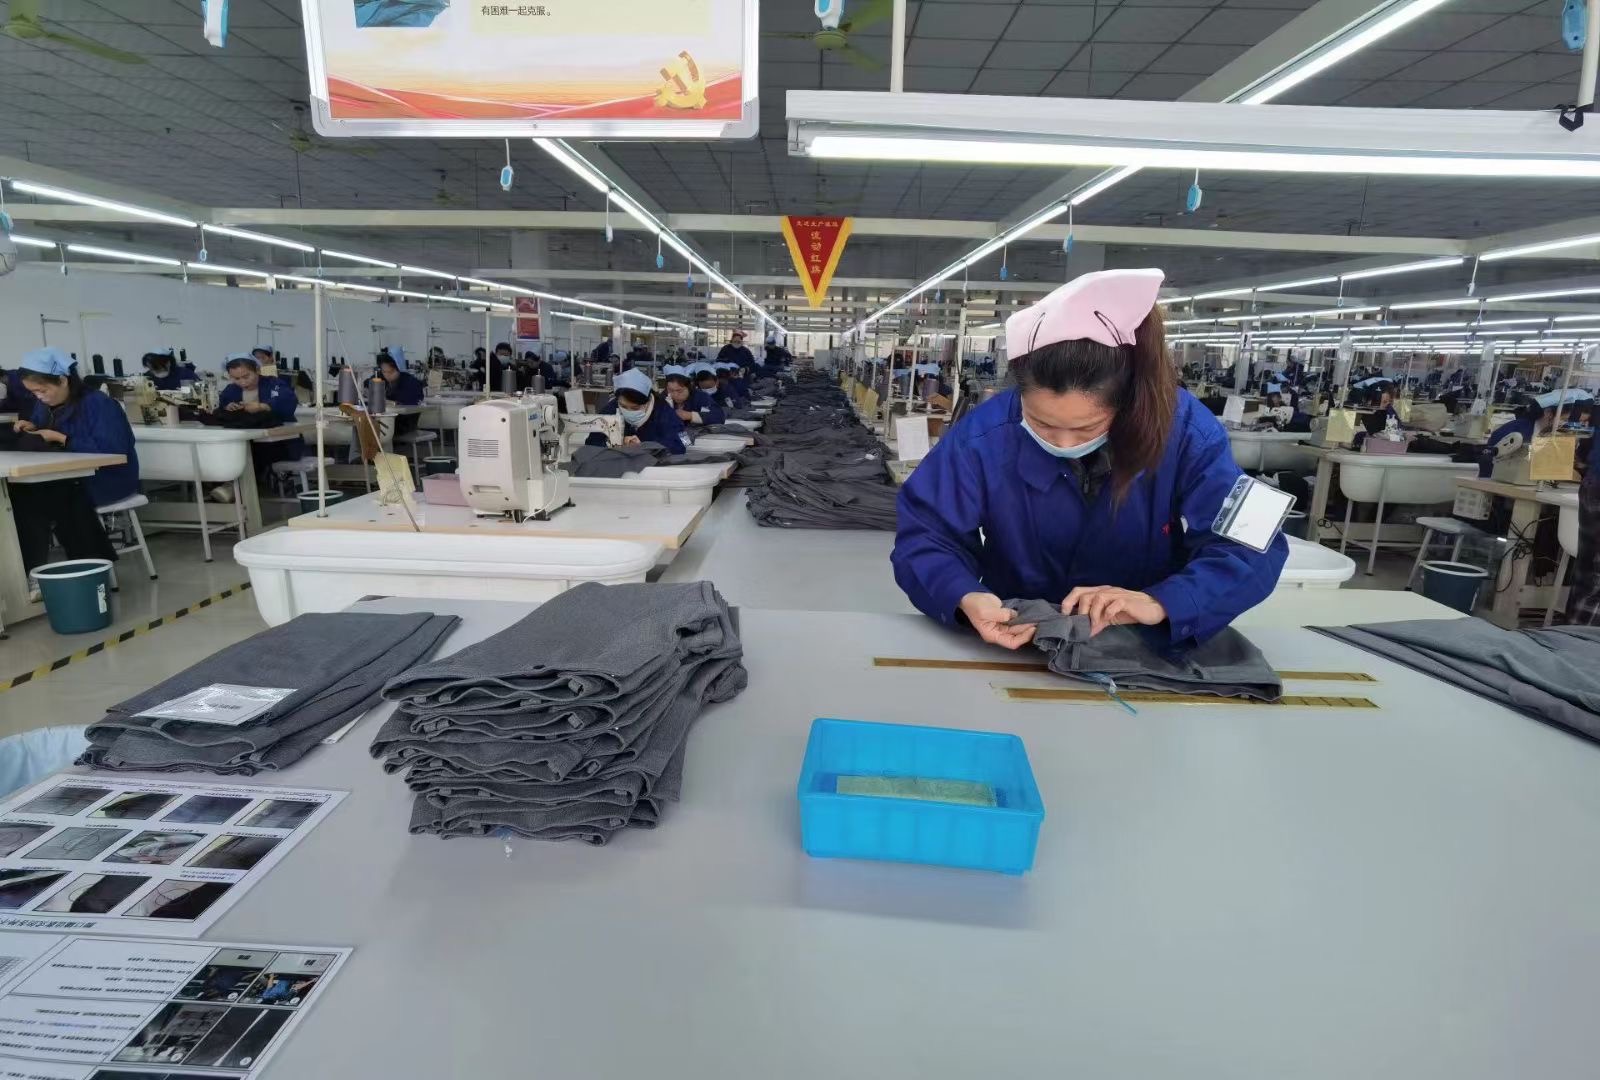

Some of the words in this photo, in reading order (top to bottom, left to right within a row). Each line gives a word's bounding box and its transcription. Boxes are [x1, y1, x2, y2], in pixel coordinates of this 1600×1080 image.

[481, 5, 551, 16] 有困难一起克服。
[810, 230, 822, 274] 流动红旗
